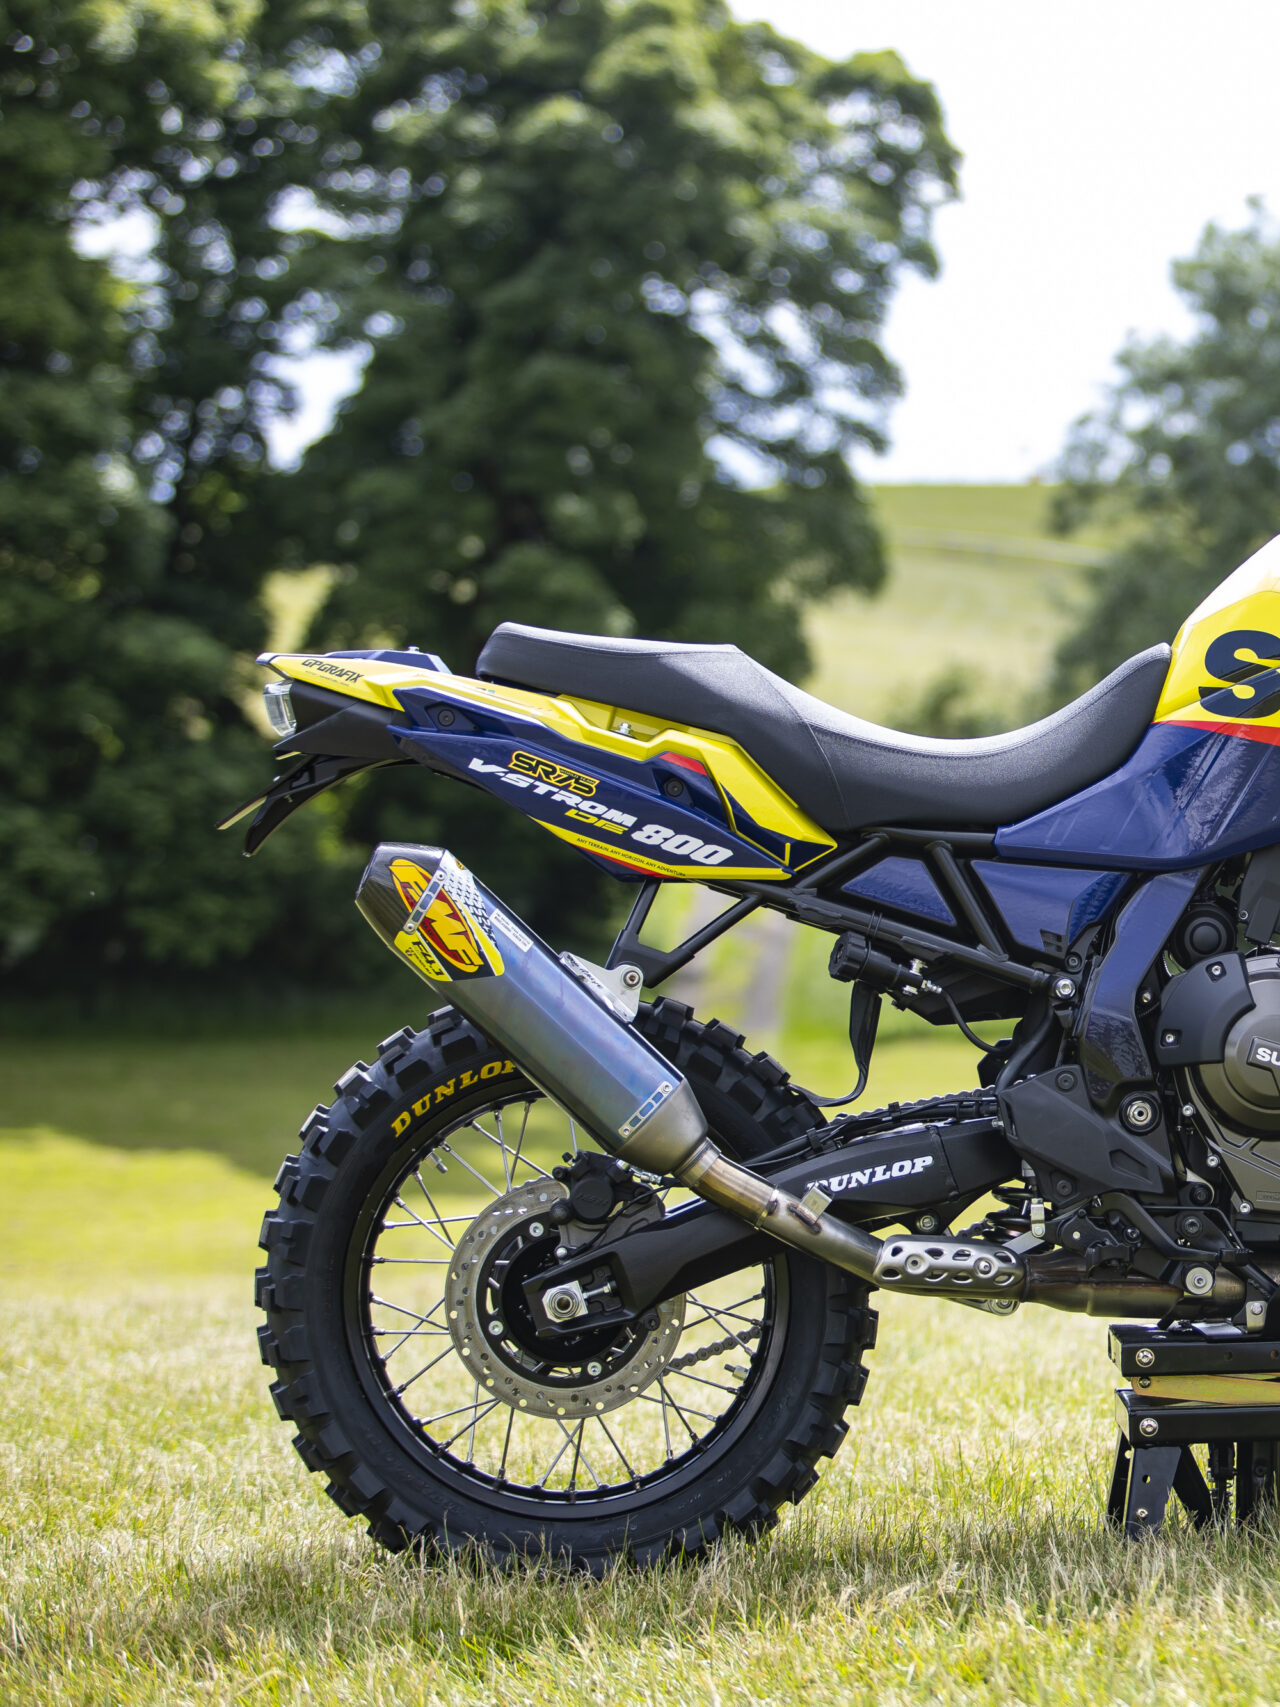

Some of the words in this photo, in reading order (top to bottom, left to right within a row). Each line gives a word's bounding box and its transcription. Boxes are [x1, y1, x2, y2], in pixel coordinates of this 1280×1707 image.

[302, 659, 364, 683] GPGRAFIX
[468, 758, 638, 827] V-STROM
[510, 751, 598, 797] SR75
[564, 809, 629, 835] DE
[630, 825, 734, 865] 800
